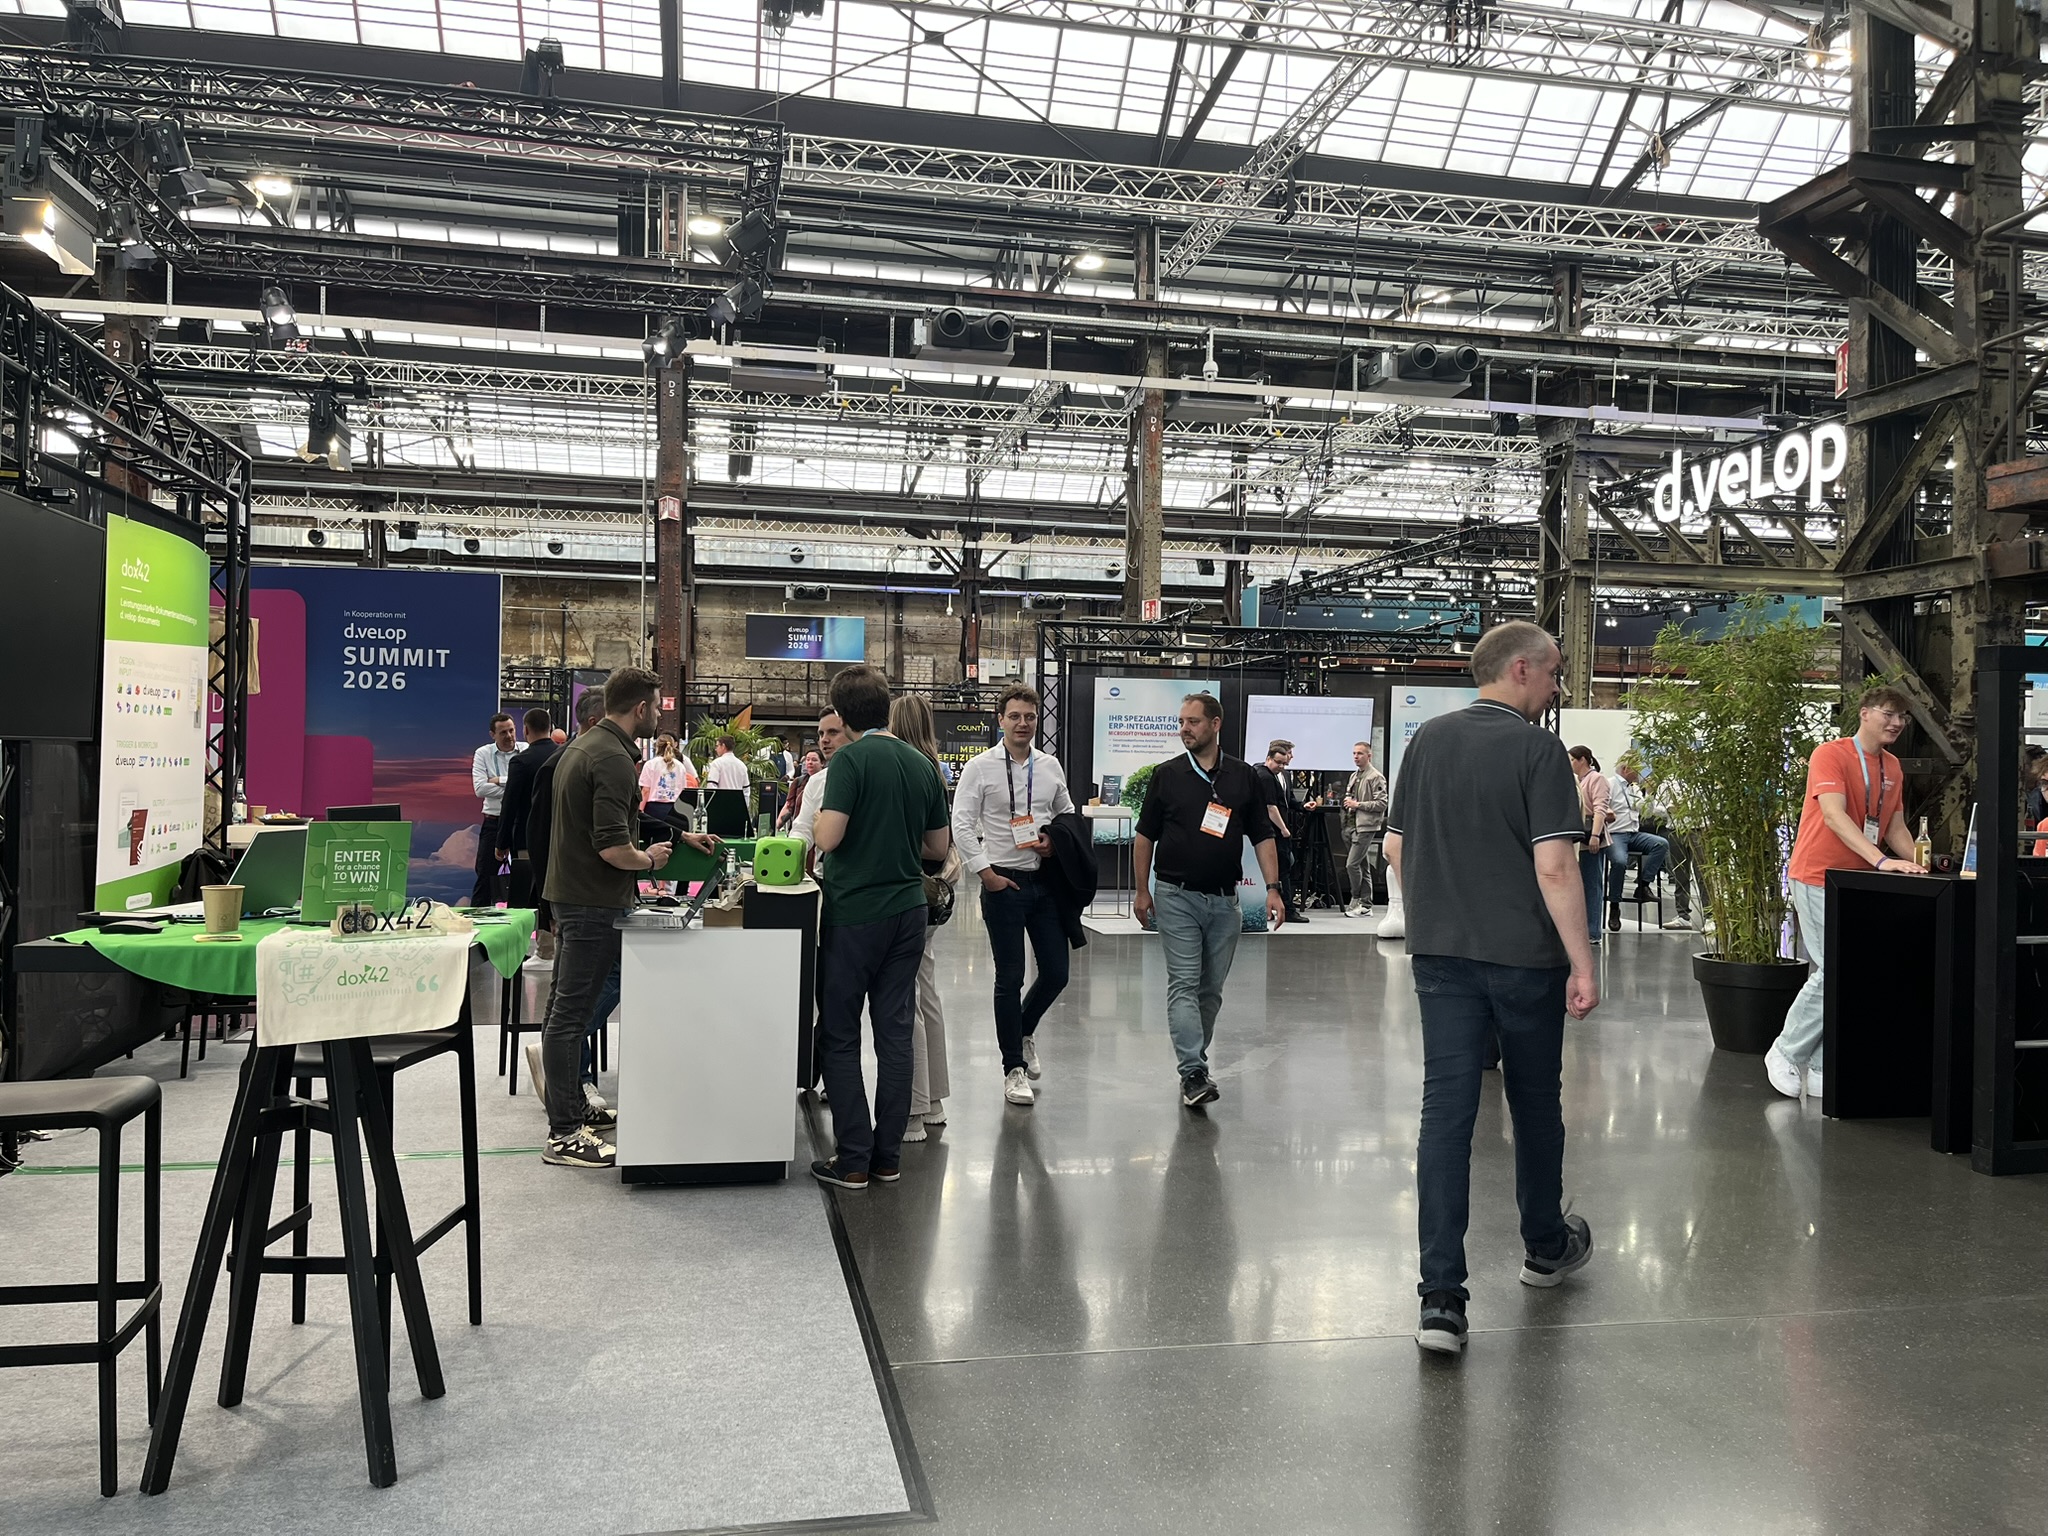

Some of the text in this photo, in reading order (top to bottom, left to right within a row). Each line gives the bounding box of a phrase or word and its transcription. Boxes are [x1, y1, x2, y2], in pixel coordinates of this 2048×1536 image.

[121, 558, 150, 582] dox42
[137, 614, 160, 627] documents
[351, 610, 393, 619] Kooperation
[787, 634, 823, 642] SUMMIT
[343, 646, 451, 668] SUMMIT
[343, 670, 406, 690] 2026
[1168, 714, 1178, 723] FÜ
[1108, 722, 1178, 731] ERP-INTEGRATION
[937, 754, 975, 762] EFFIZIE
[334, 850, 381, 863] ENTER
[334, 863, 345, 871] for
[333, 871, 380, 883] TO WIN
[341, 900, 432, 934] dox42
[337, 966, 390, 986] dox42
